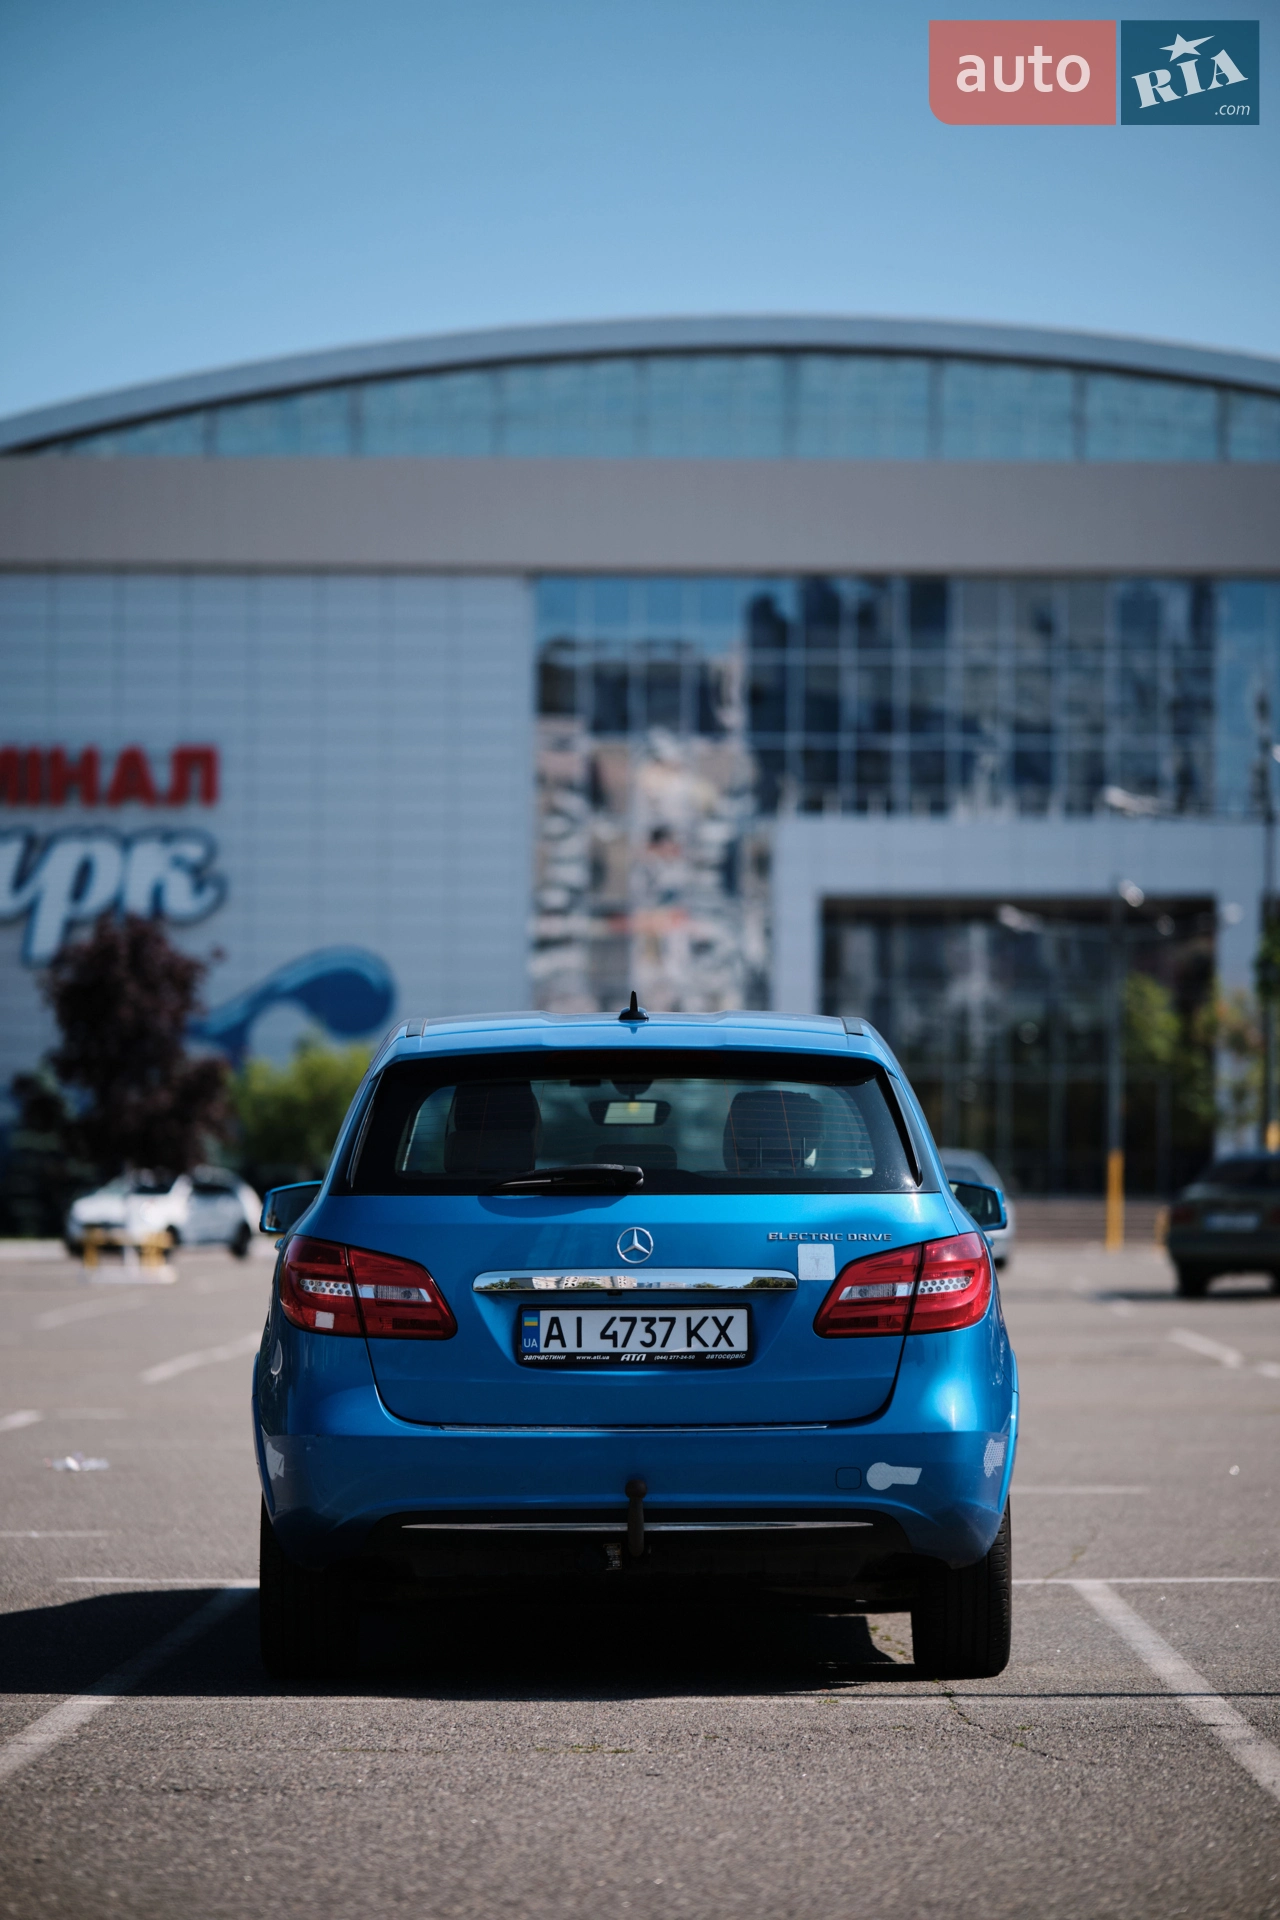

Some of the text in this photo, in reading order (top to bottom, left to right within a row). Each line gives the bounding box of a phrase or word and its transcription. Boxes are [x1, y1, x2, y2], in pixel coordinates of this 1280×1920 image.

[768, 1232, 892, 1241] ELECTRIC DRIVE
[600, 1316, 676, 1348] 4737
[686, 1316, 735, 1348] KX
[523, 1338, 538, 1348] UA
